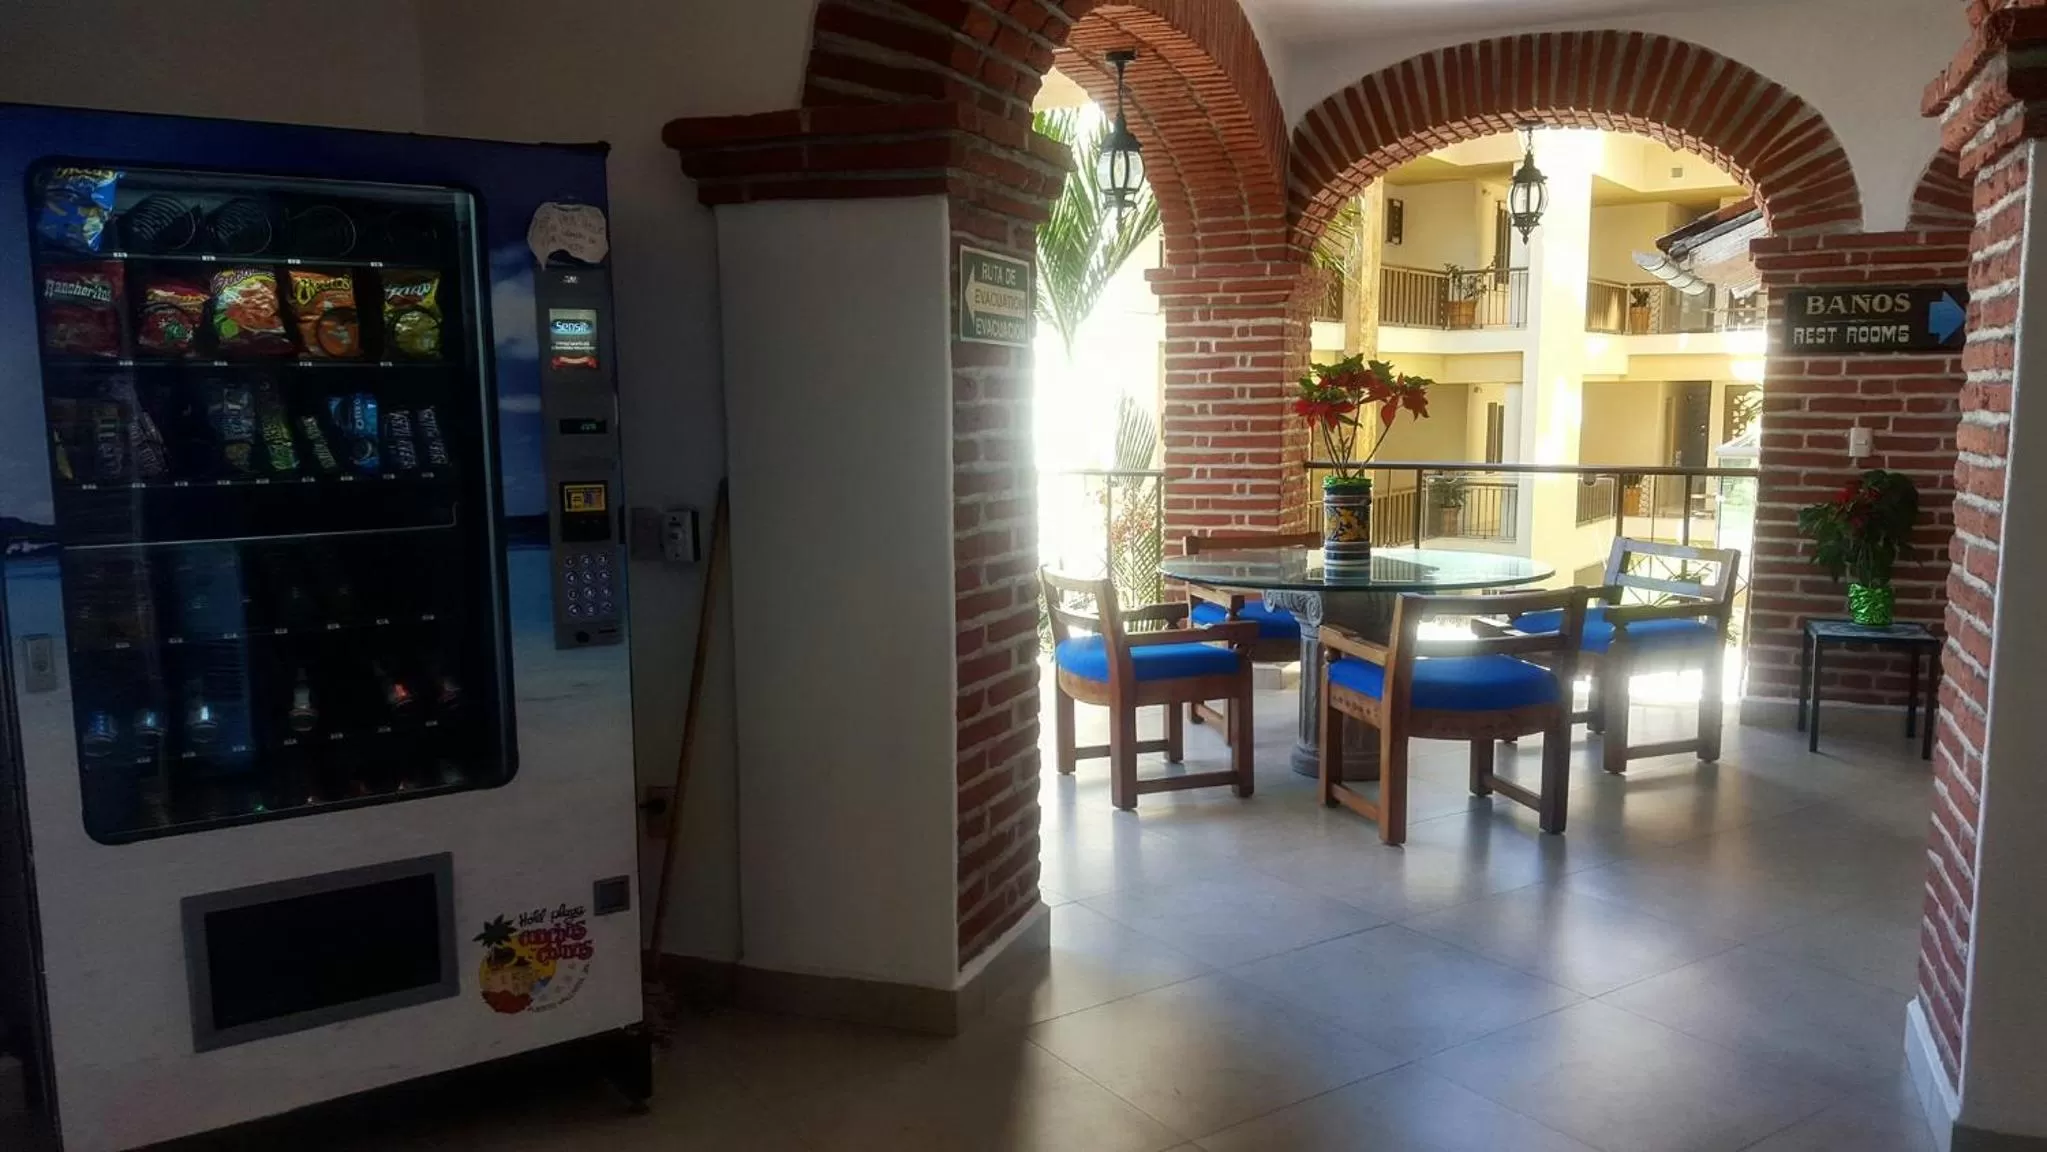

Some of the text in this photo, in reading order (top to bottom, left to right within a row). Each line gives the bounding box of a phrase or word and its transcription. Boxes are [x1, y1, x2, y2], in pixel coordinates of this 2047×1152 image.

[982, 262, 1017, 286] RUTA DE
[1793, 325, 1911, 344] REST ROOMS
